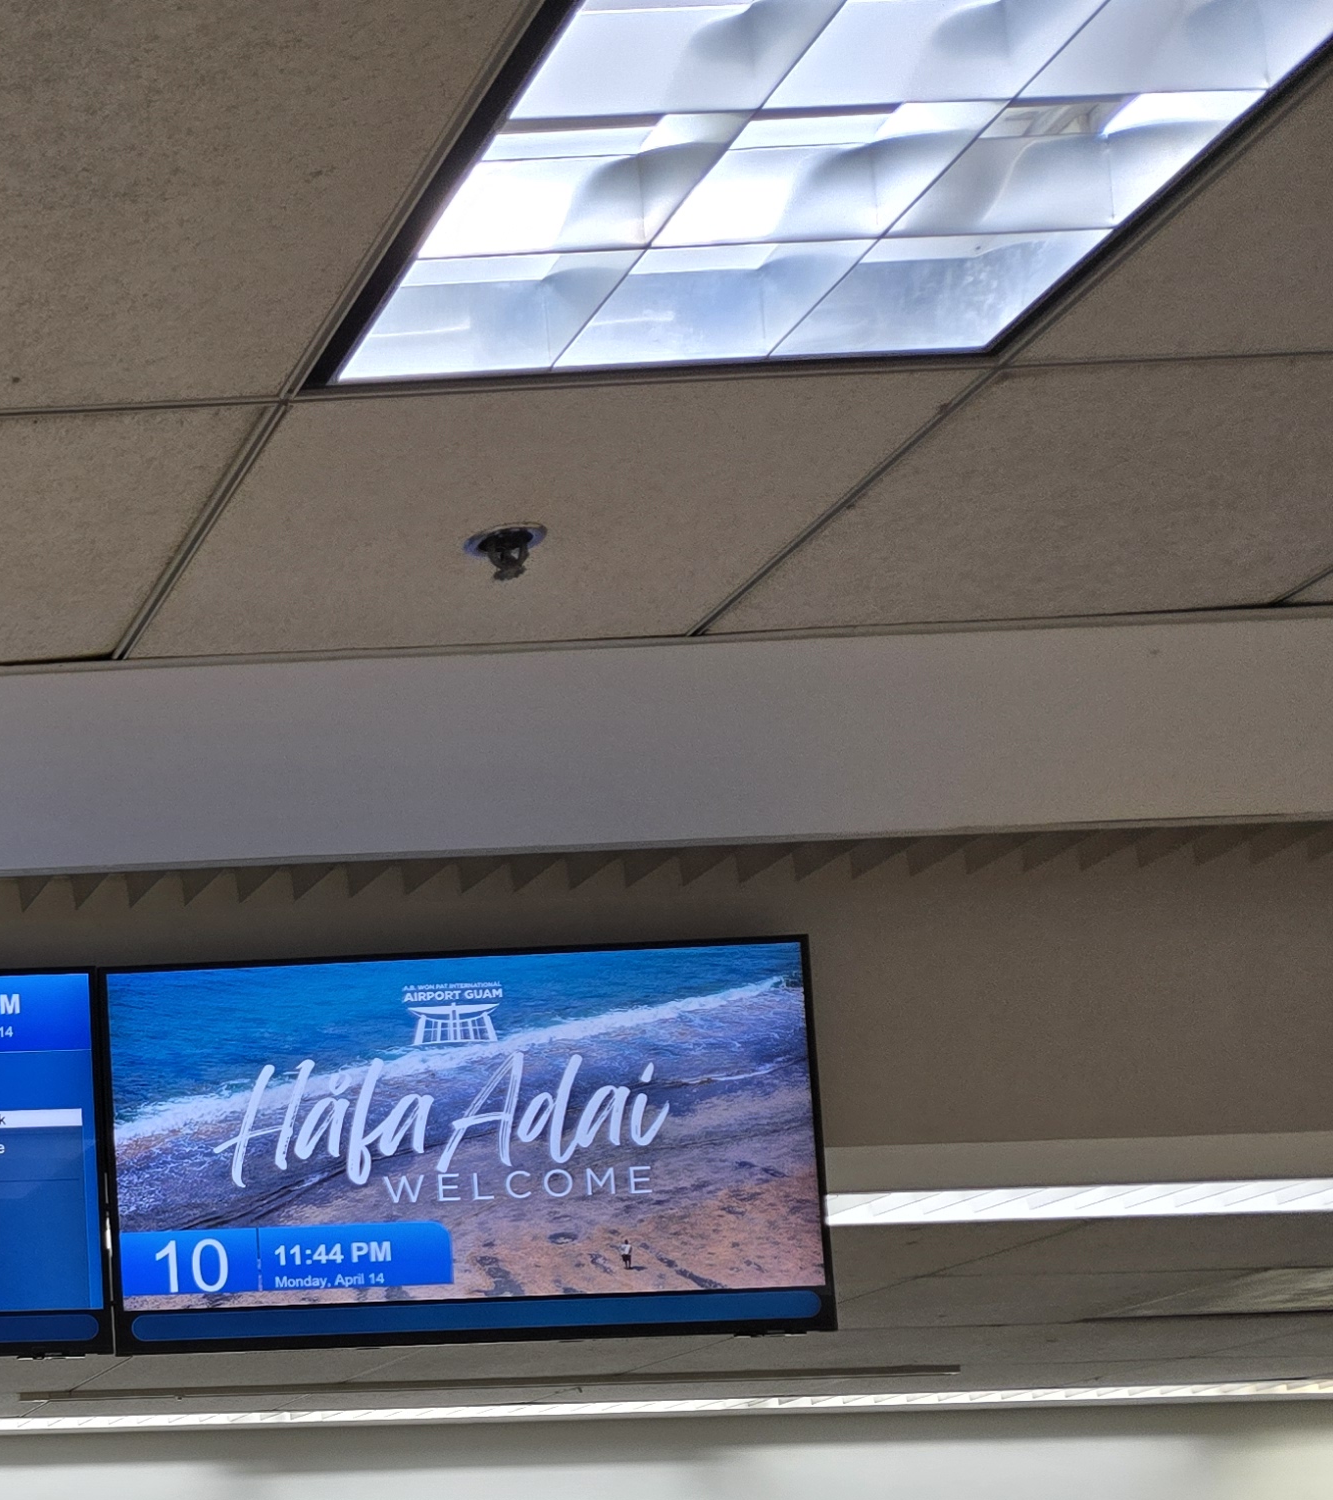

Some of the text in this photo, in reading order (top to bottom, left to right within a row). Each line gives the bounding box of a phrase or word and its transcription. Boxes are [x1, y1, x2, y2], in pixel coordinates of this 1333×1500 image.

[403, 989, 503, 1002] AIRPORT GUAM
[437, 1052, 670, 1173] Adai
[384, 1165, 654, 1203] WELCOME
[153, 1238, 230, 1293] 10
[275, 1241, 392, 1266] 11:44 PM
[275, 1273, 385, 1289] Monday, April 14
